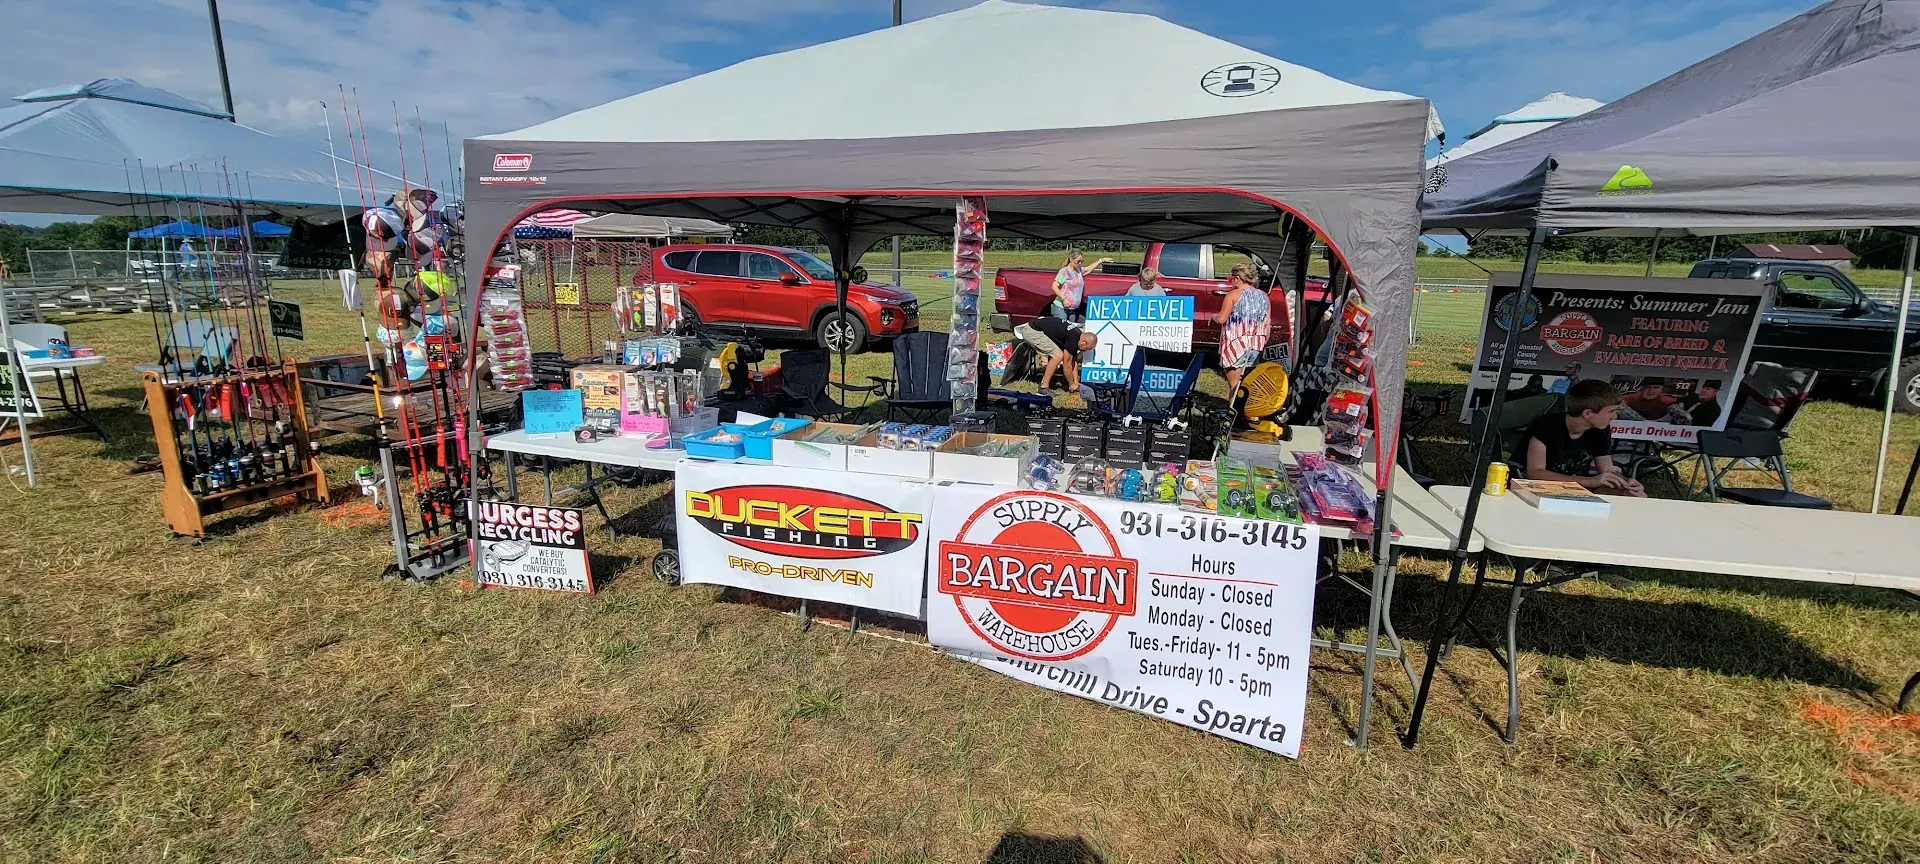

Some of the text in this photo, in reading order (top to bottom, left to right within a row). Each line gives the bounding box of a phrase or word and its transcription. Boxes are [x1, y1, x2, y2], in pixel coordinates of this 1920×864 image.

[497, 157, 523, 167] Coleman
[1089, 299, 1189, 320] NEXT LEVEL
[1548, 291, 1625, 310] Presents:
[1630, 294, 1708, 313] Summer
[1707, 298, 1750, 317] Jam
[1139, 325, 1189, 338] PRESSURE
[1544, 327, 1600, 340] BARGAIN
[1630, 317, 1710, 333] FEATURING
[1517, 351, 1538, 359] County
[1607, 333, 1726, 354] RARE OF BREED &
[1593, 351, 1729, 372] EVANGELIST KELLY K
[1646, 426, 1677, 438] Drive
[1680, 428, 1692, 438] In
[686, 490, 922, 540] DUCKETT
[993, 500, 1094, 537] SUPPLY
[478, 522, 576, 546] RECYCLING
[723, 523, 877, 549] FISHING
[1120, 510, 1307, 550] 931-316-3145
[530, 557, 565, 567] CATALYTIC
[538, 548, 564, 559] WE BUY
[1191, 553, 1236, 576] Hours
[478, 570, 584, 591] (931) 316-3145
[522, 564, 568, 576] CONVERTERS!
[728, 555, 873, 588] PRO-DRIVEN
[948, 551, 1128, 605] BARGAIN
[1151, 578, 1205, 605] Sunday
[1222, 584, 1273, 608] Closed
[978, 607, 1095, 653] WAREHOUSE
[1148, 605, 1204, 632] Monday
[1221, 611, 1272, 637] Closed
[1128, 631, 1221, 660] Tues.-Friday-
[1227, 641, 1240, 661] 11
[1257, 646, 1291, 671] 5pm
[1139, 658, 1203, 686] Saturday
[1208, 666, 1223, 686] 10
[1239, 672, 1273, 698] 5pm
[1101, 680, 1169, 715] Drive
[1193, 699, 1287, 744] Sparta
